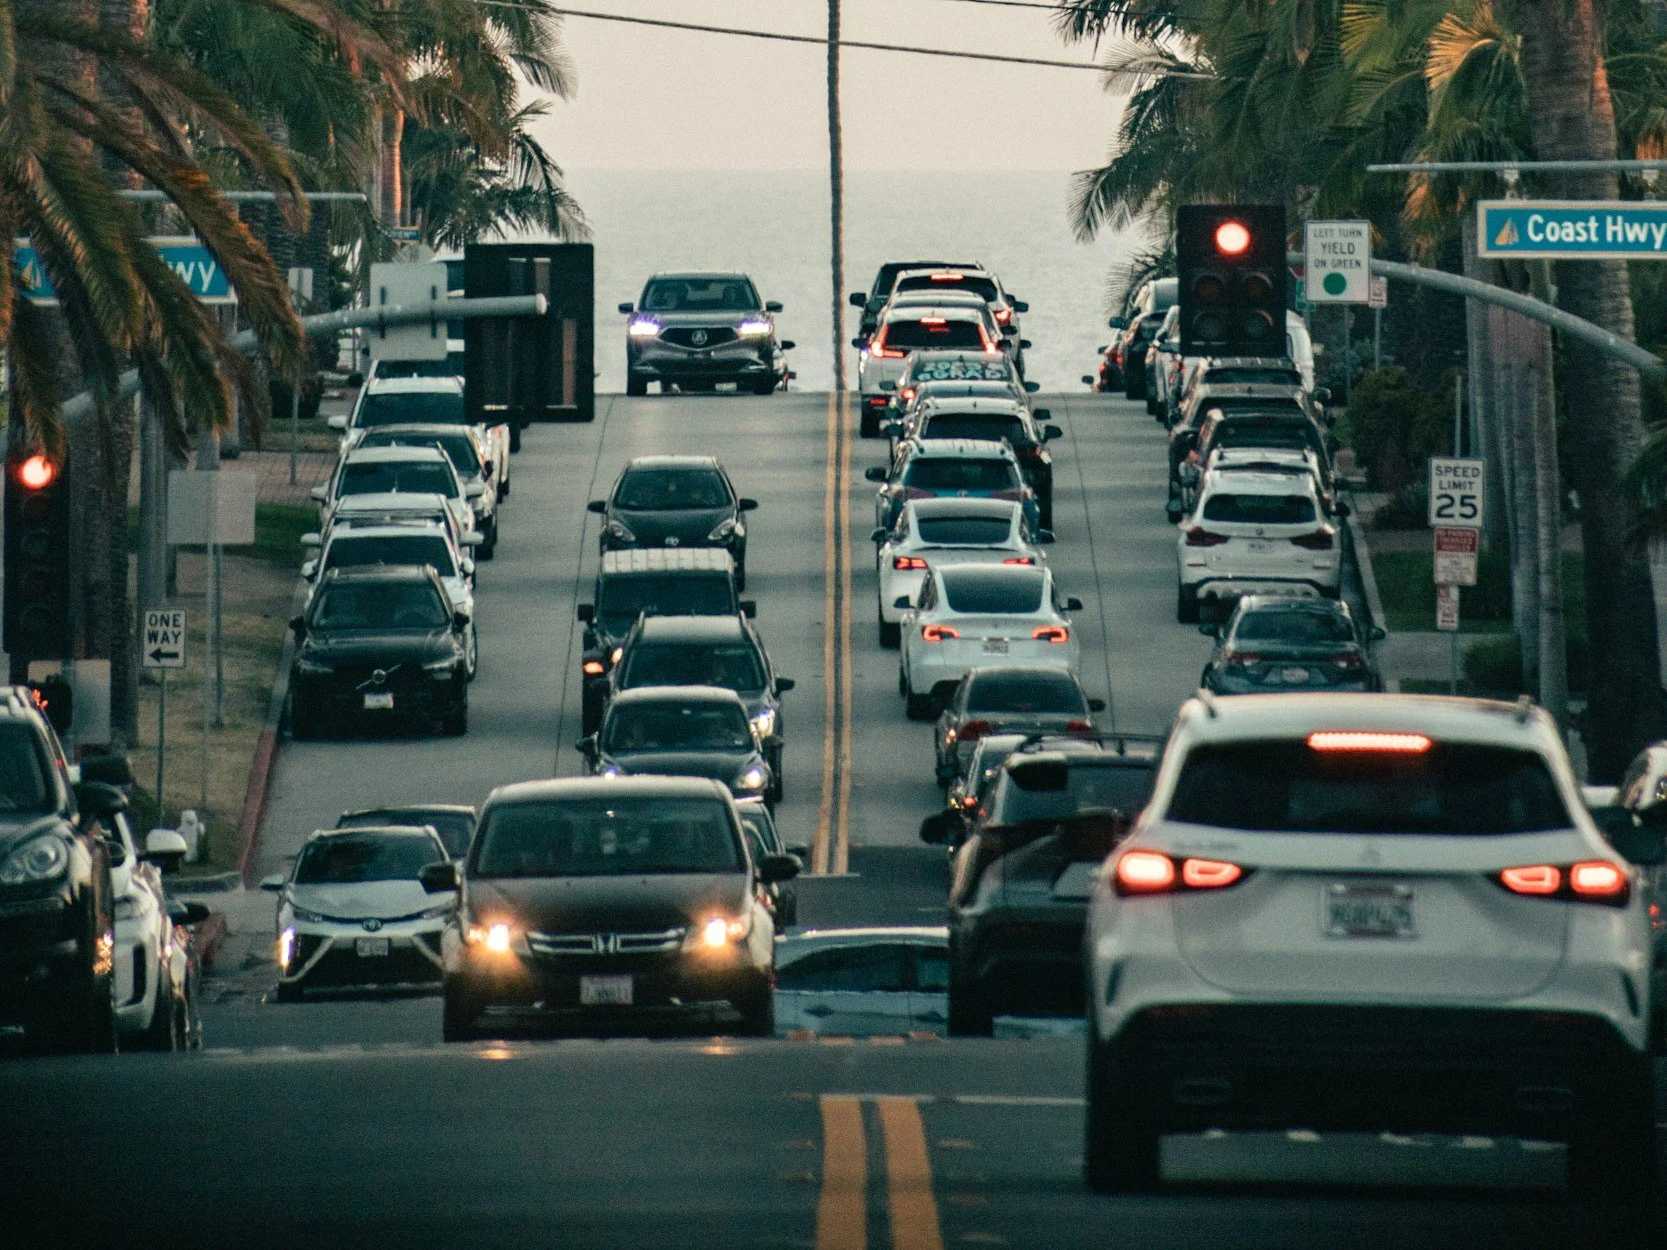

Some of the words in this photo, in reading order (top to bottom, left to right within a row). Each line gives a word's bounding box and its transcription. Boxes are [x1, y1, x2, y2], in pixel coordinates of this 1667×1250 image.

[1313, 228, 1334, 238] LEFT
[1339, 229, 1363, 238] TURN
[1527, 213, 1599, 243] Coast
[1605, 214, 1667, 250] Hwy
[1320, 242, 1356, 255] YIELD
[1313, 258, 1327, 269] ON
[1331, 258, 1362, 269] GREEN
[1435, 464, 1480, 478] SPEED
[1438, 480, 1475, 491] LIMIT
[1435, 493, 1478, 519] 25
[149, 613, 182, 628] ONE
[147, 629, 182, 645] WAY
